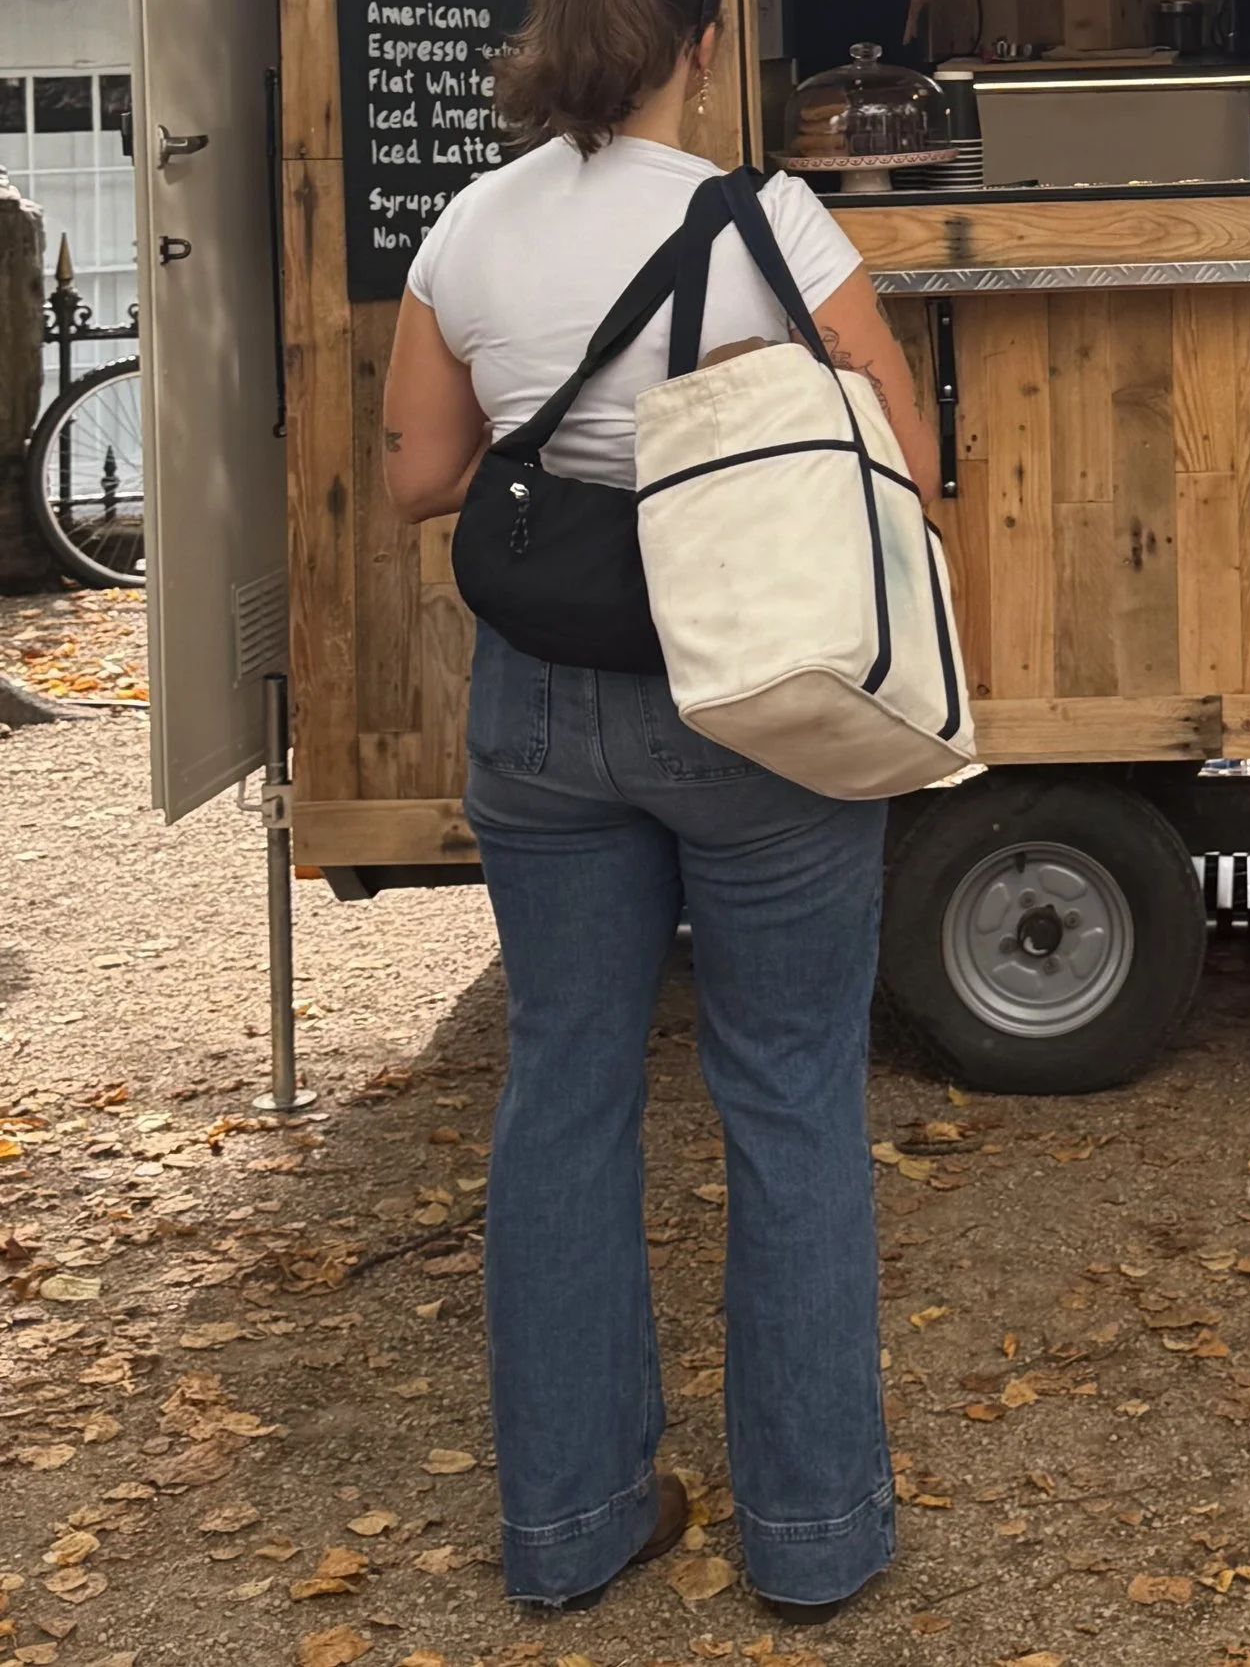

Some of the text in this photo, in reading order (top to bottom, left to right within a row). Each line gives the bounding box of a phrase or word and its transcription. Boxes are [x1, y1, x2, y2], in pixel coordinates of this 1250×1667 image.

[367, 1, 491, 29] Americano
[368, 34, 468, 67] Espresso
[368, 68, 496, 97] Flat White
[369, 101, 418, 129] Iced
[371, 137, 502, 164] Iced Latte
[369, 187, 446, 219] Syrups
[373, 226, 412, 249] Non
